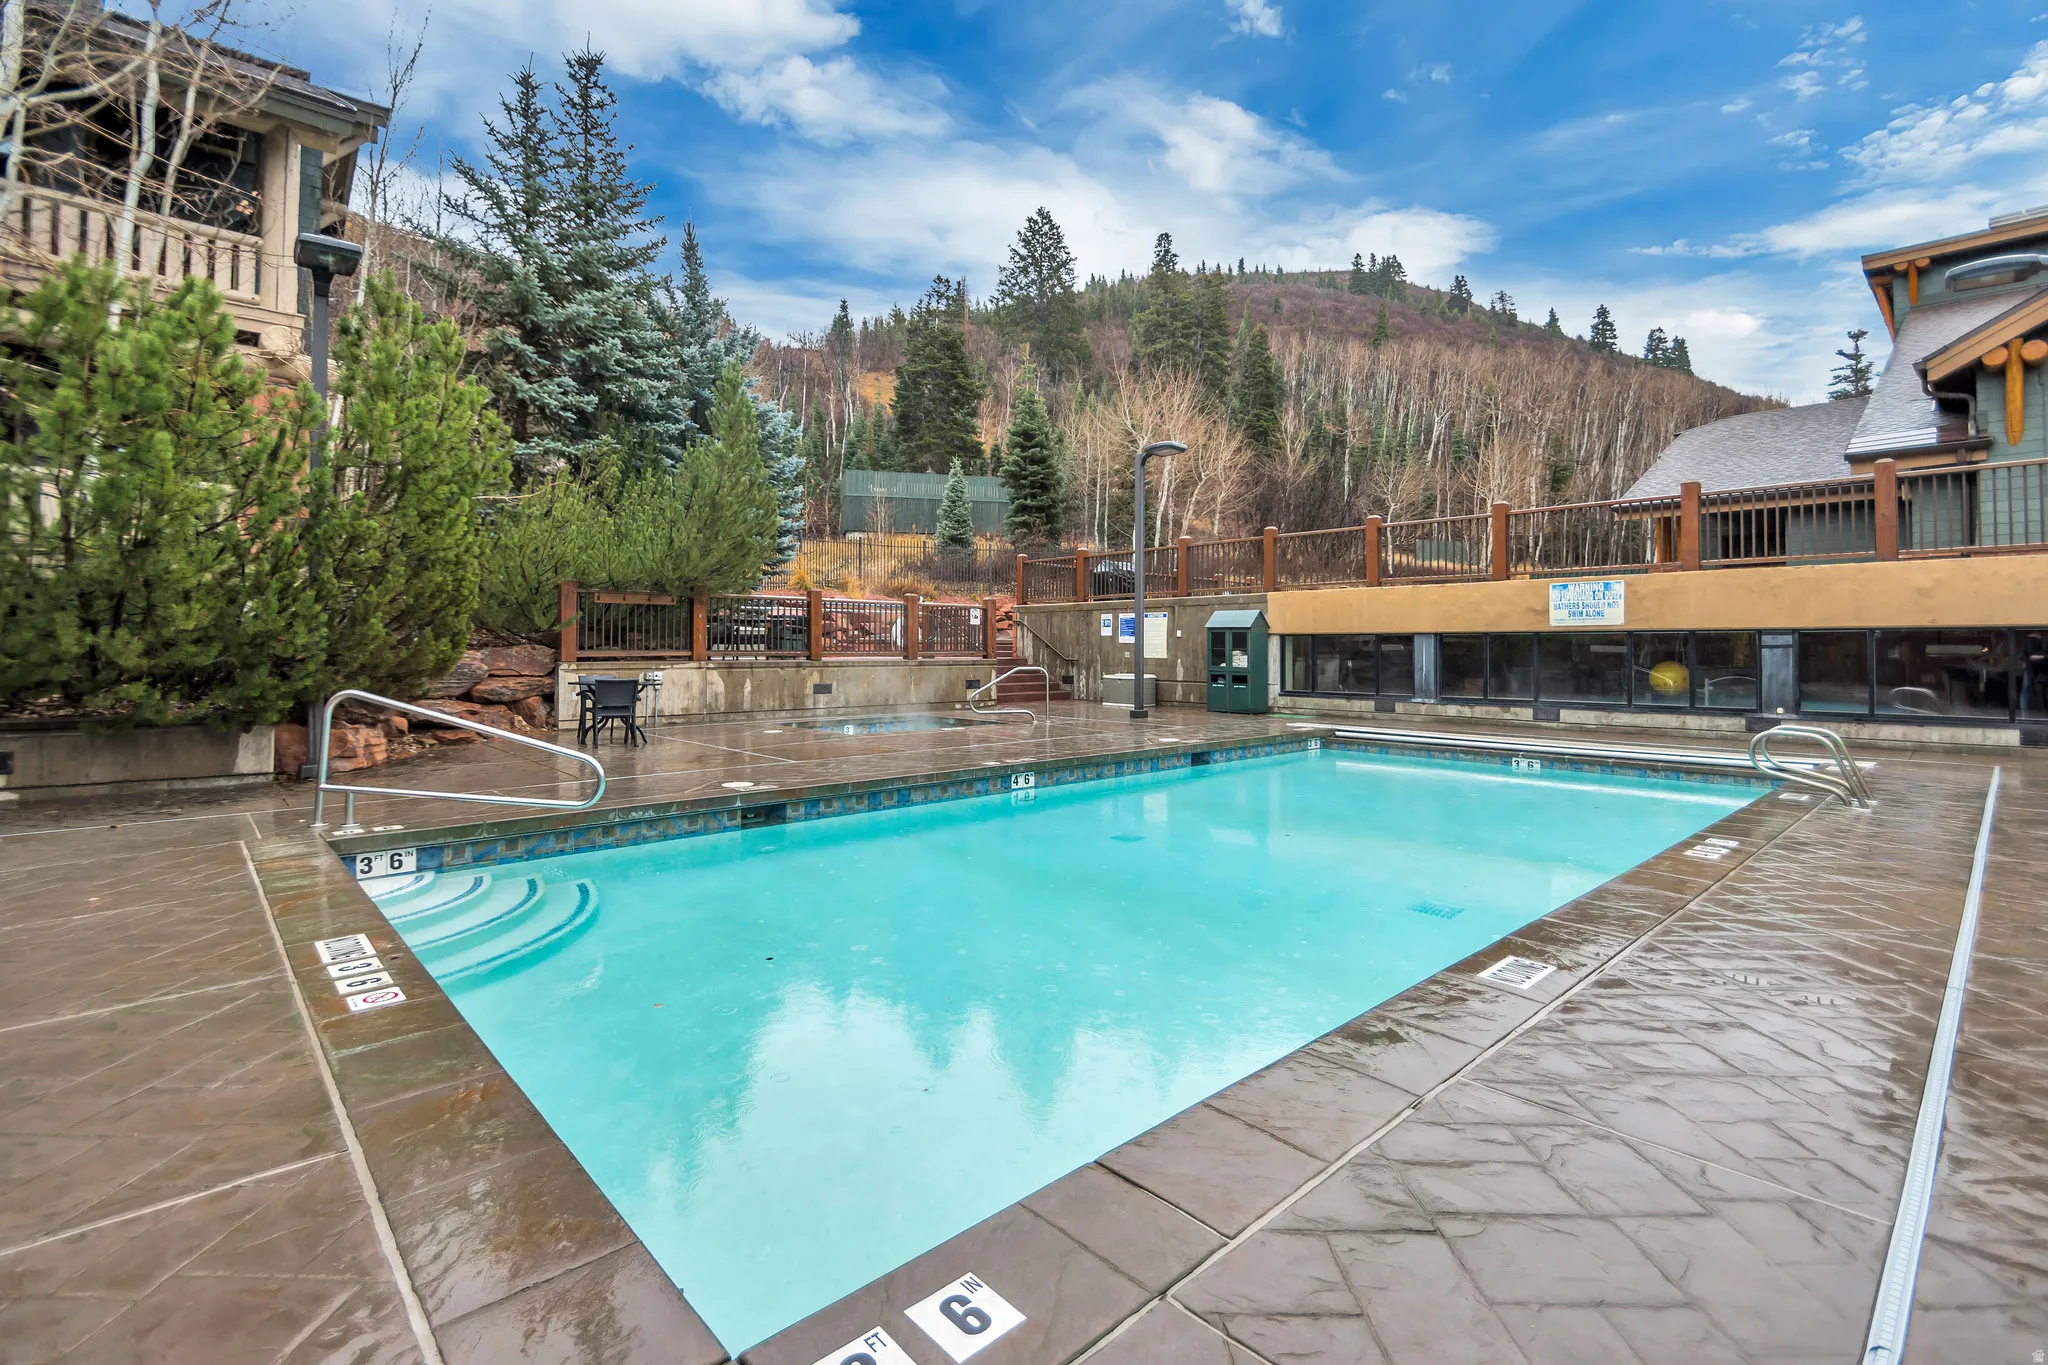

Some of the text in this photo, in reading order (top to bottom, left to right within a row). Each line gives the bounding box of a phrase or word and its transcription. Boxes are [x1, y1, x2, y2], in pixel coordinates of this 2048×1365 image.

[1567, 582, 1604, 592] WARNING
[1553, 600, 1619, 610] BATHERS SHOULD NOT
[1568, 609, 1605, 618] SWIM ALONE
[1024, 773, 1030, 785] 6
[359, 857, 373, 874] 3
[390, 853, 403, 870] 6
[338, 963, 373, 972] 3
[346, 977, 382, 987] 6
[939, 1276, 992, 1335] 6 IN
[863, 1332, 887, 1353] FT
